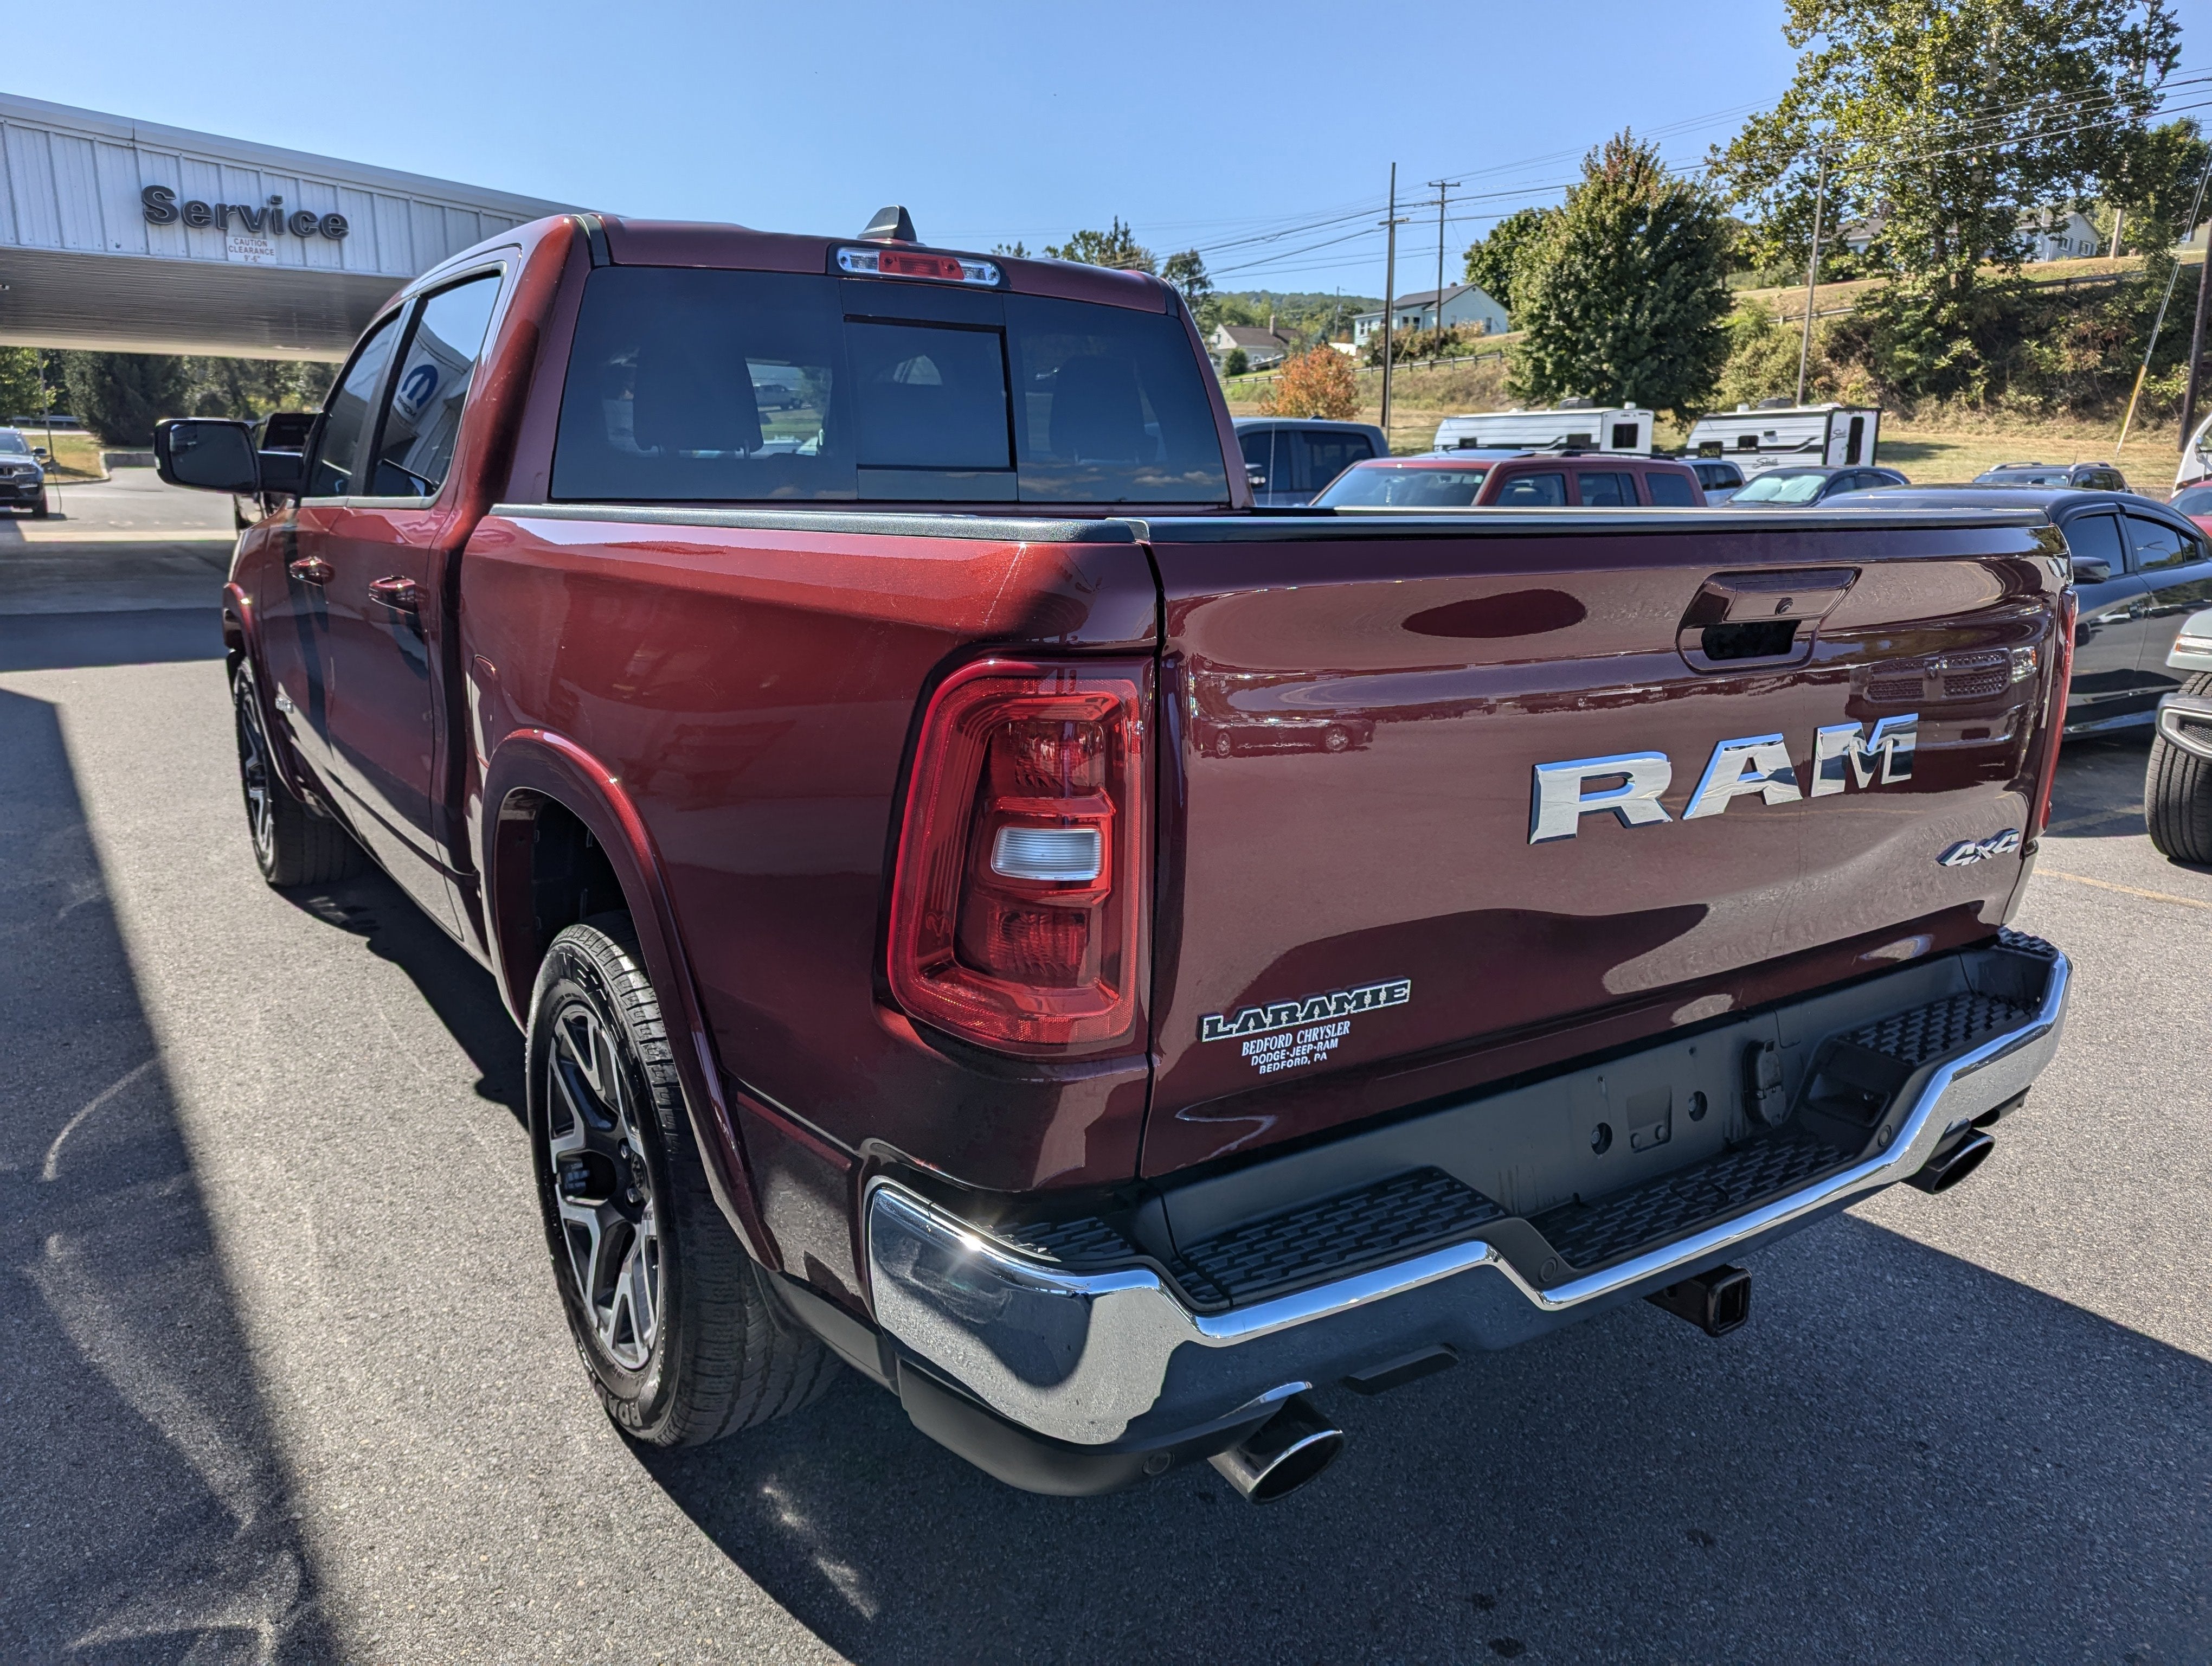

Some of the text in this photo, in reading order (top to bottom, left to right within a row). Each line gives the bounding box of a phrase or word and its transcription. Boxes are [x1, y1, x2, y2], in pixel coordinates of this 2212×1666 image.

[142, 185, 349, 240] Service
[229, 246, 274, 255] CLEARANCE
[234, 238, 267, 247] CAUTION
[1527, 713, 1919, 845] RAM
[1198, 977, 1411, 1042] LARAMIE
[1242, 1021, 1351, 1056] BEDFORD CHRYSLER
[1259, 1052, 1328, 1075] BEDFORD, PA
